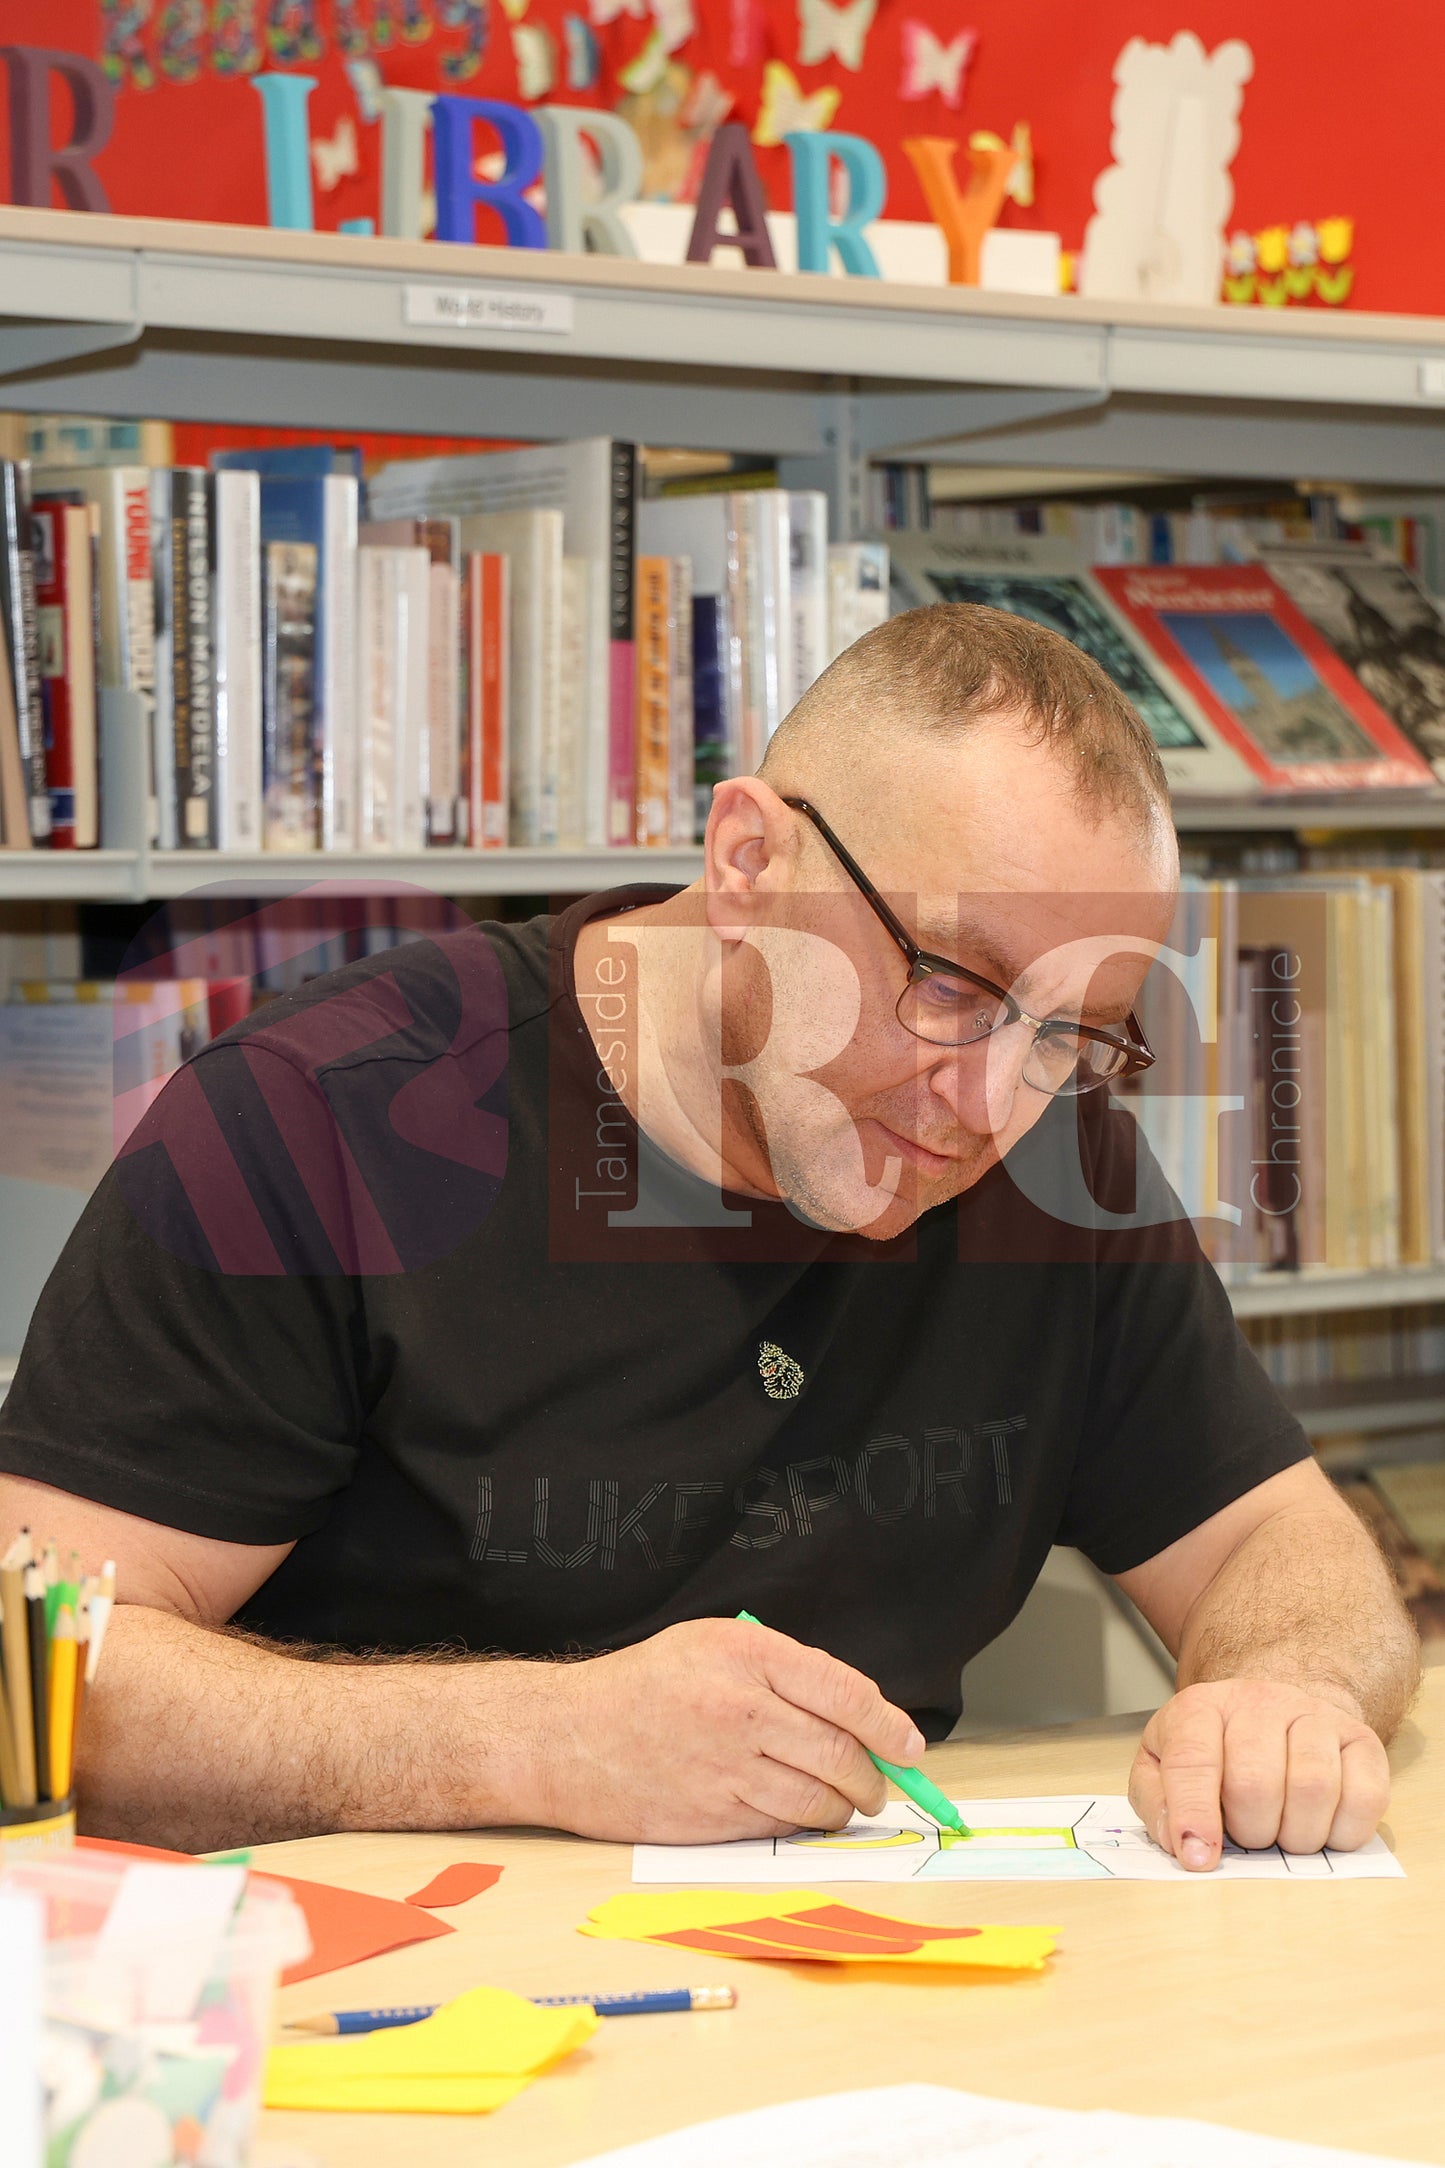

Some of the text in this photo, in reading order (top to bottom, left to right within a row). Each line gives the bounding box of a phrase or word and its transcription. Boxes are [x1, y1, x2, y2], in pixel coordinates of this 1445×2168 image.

[250, 72, 1020, 286] LIBRARY
[125, 487, 157, 694] YOUNG MANDEL
[187, 490, 213, 796] NELSON MANDELA
